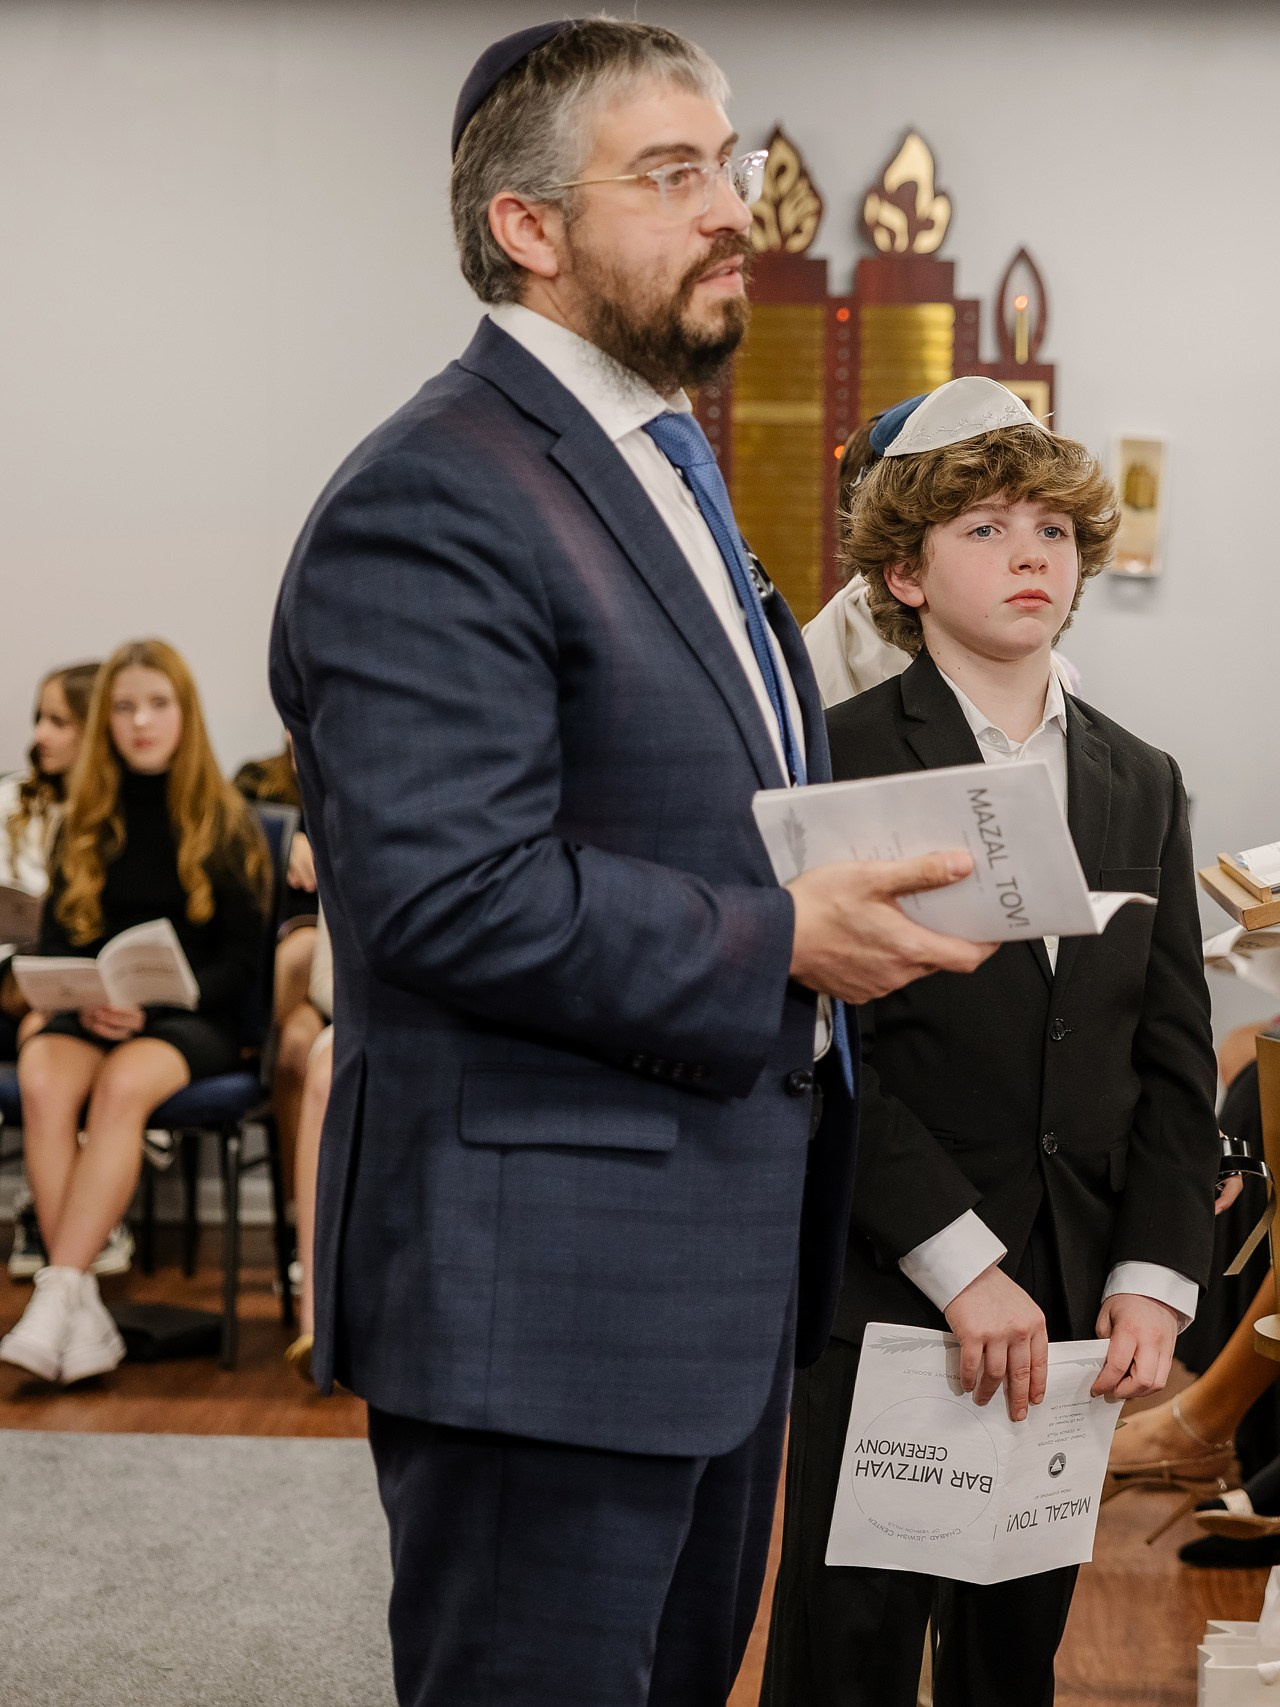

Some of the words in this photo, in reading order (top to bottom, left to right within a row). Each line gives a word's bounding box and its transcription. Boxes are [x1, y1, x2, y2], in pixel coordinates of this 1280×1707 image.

[966, 787, 1008, 870] MAZAL
[995, 876, 1031, 928] TOV!
[902, 1369, 932, 1377] BOOKLET
[854, 1438, 948, 1462] CEREMONY
[855, 1459, 944, 1485] MITZVAH
[950, 1469, 993, 1494] BAR
[1006, 1509, 1038, 1532] TOV!
[1045, 1496, 1092, 1523] MAZAL
[867, 1517, 895, 1537] CENTER
[896, 1532, 927, 1542] JEWISH
[929, 1527, 962, 1541] CHABAD
